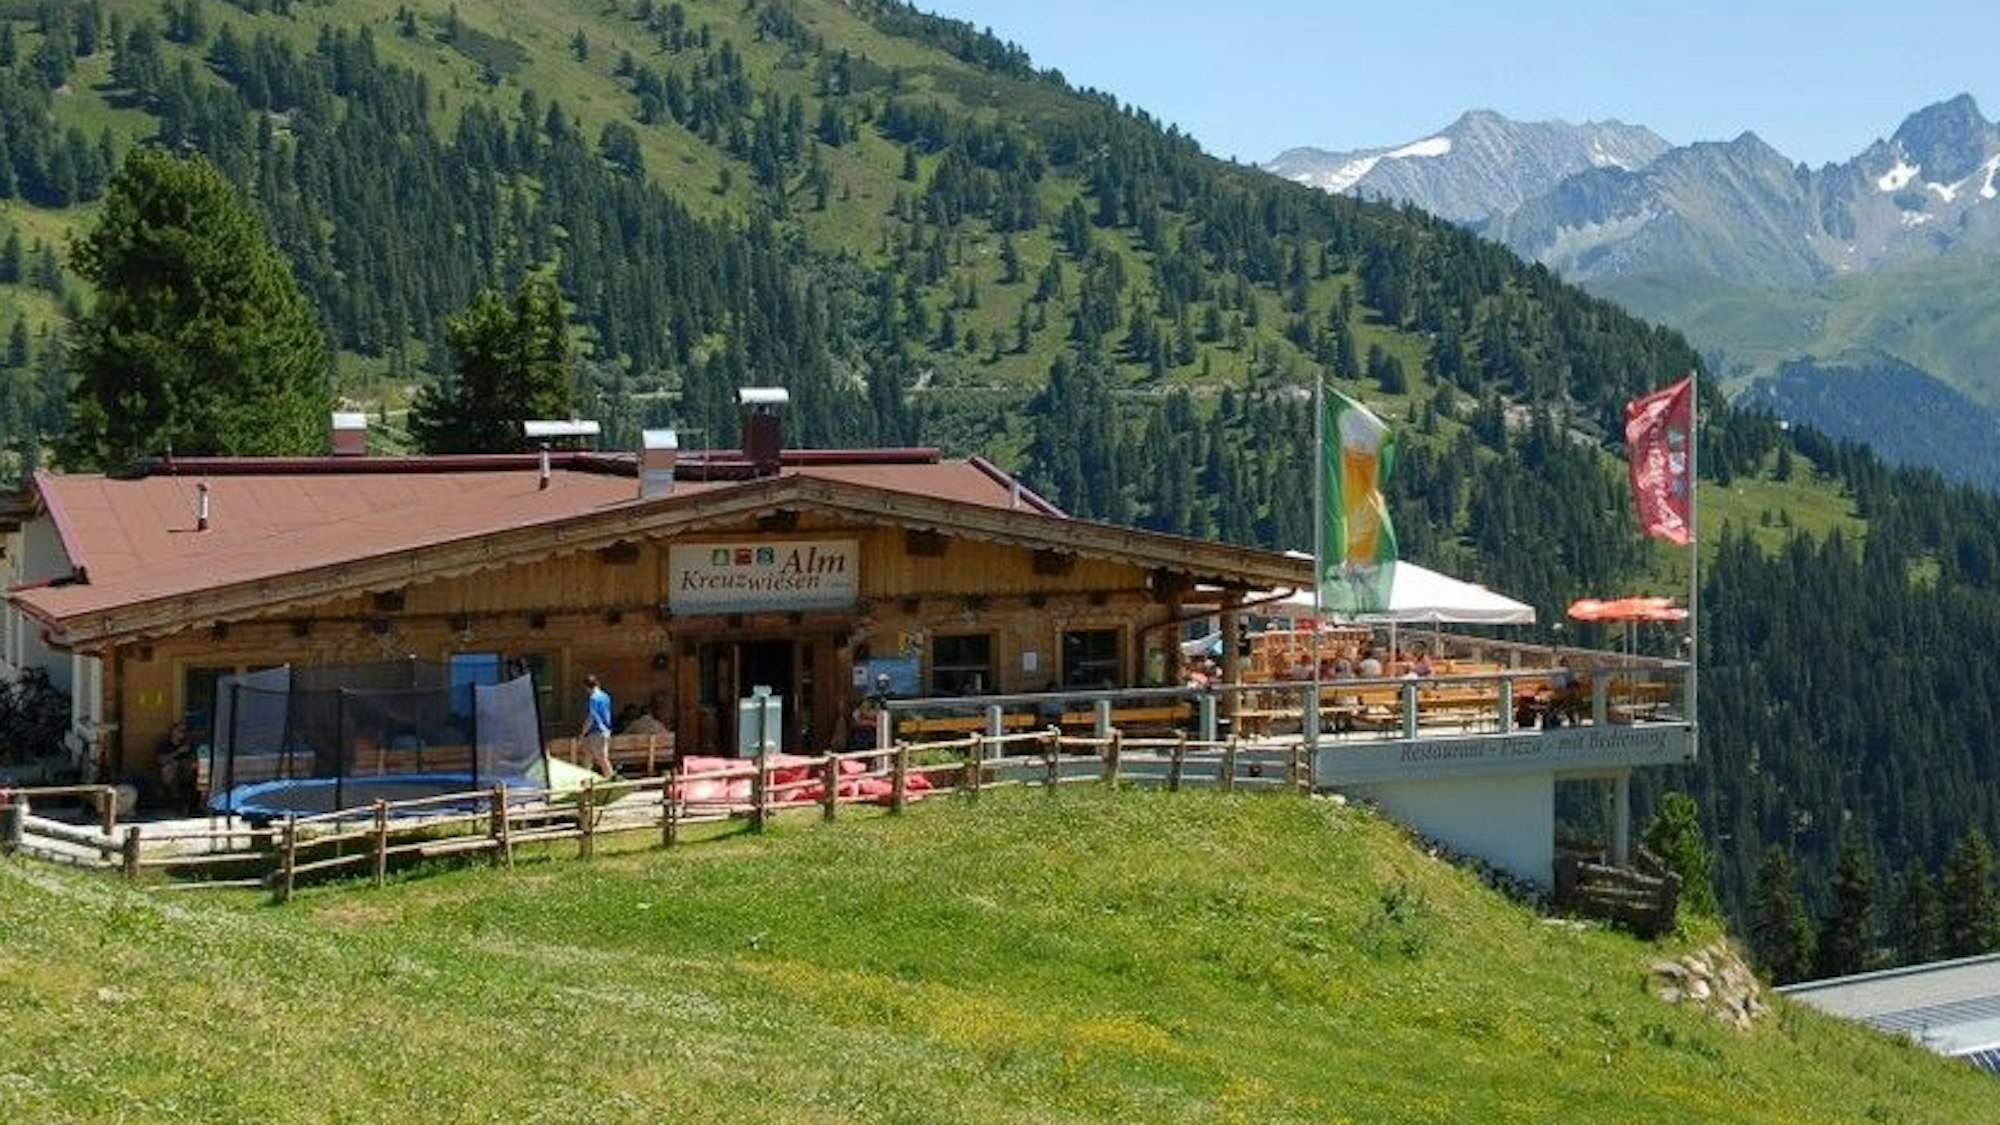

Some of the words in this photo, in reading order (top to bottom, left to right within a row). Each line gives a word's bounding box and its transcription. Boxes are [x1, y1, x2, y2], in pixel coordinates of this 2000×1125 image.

[781, 546, 846, 574] Alm
[681, 571, 820, 591] Kreuzwiesen
[1401, 741, 1484, 762] Restaurant
